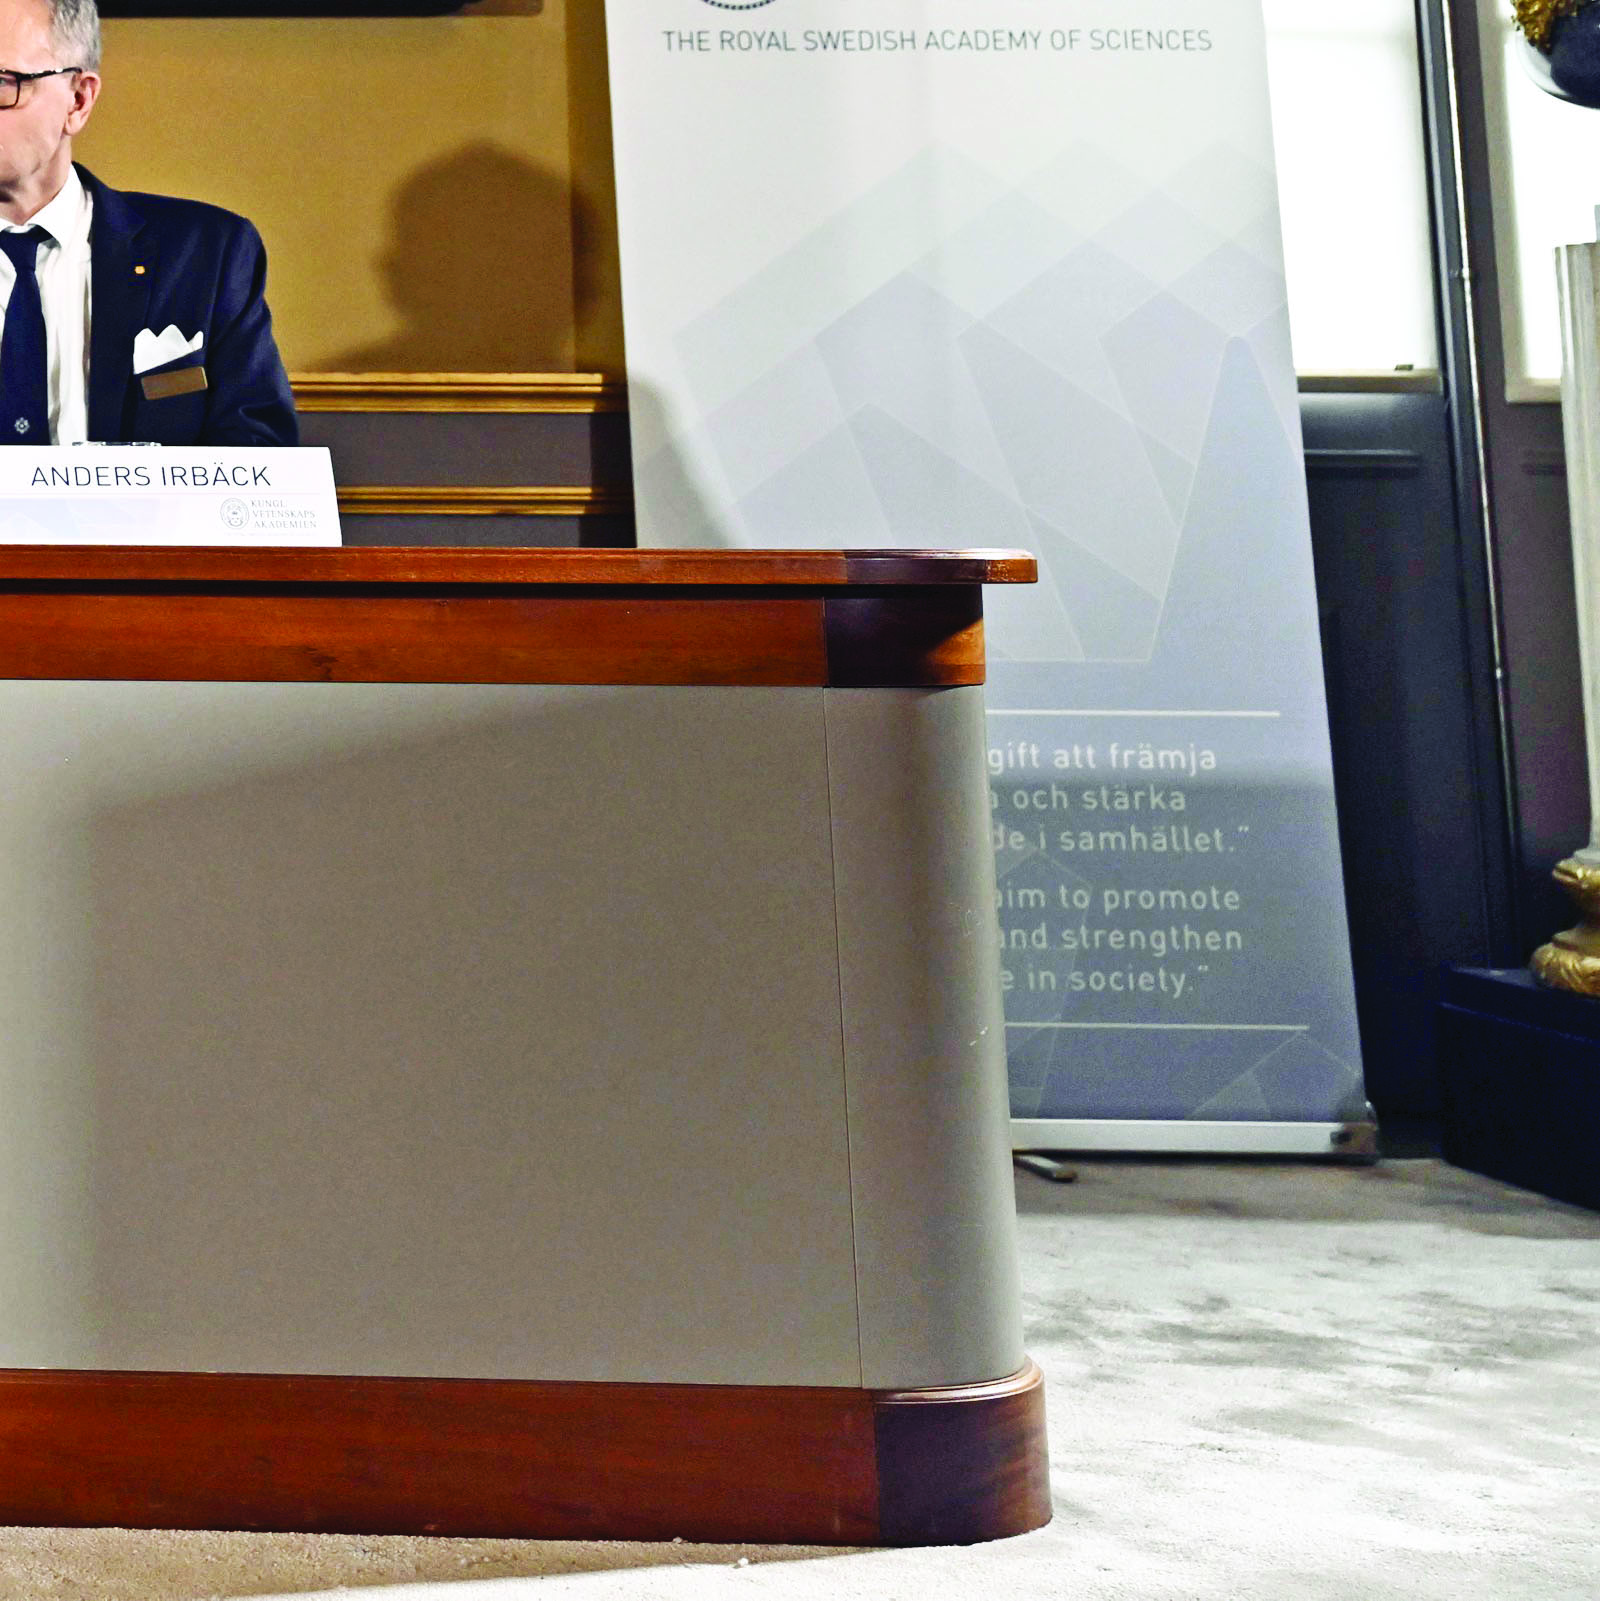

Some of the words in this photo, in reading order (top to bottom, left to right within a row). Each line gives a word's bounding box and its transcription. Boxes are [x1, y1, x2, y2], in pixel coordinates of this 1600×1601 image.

[663, 31, 710, 51] THE
[720, 30, 796, 51] ROYAL
[803, 30, 916, 51] SWEDISH
[925, 30, 1040, 50] ACADEMY
[1050, 29, 1080, 50] OF
[1090, 29, 1212, 51] SCIENCES
[32, 467, 150, 486] ANDERS
[162, 462, 271, 487] IRBÄCK
[1053, 744, 1097, 769] att
[1109, 743, 1217, 776] främja
[1013, 784, 1068, 810] och
[1082, 784, 1186, 811] stärka
[1039, 825, 1047, 850] i
[1060, 884, 1090, 909] to
[1103, 886, 1240, 915] promote
[1061, 923, 1242, 957] strengthen
[1028, 963, 1056, 991] in
